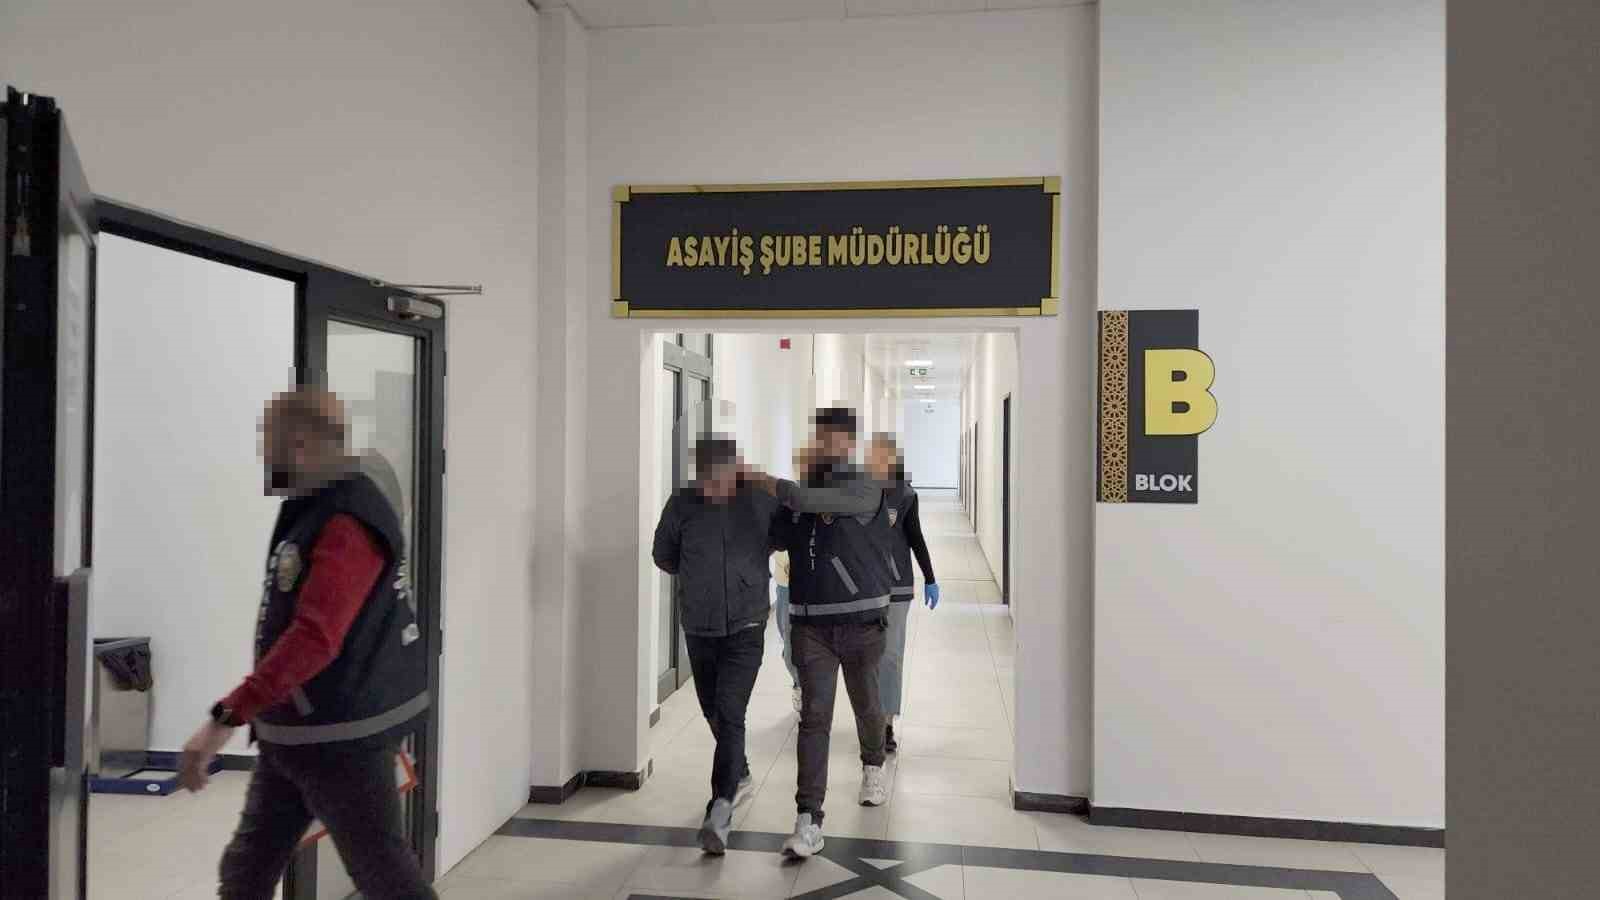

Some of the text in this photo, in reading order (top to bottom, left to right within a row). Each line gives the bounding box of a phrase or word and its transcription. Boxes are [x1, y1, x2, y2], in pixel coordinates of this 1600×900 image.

[666, 224, 991, 275] ASAYİŞ ŞUBE MÜDÜRLÜĞÜ
[1144, 349, 1218, 436] B
[1135, 474, 1193, 492] BLOK
